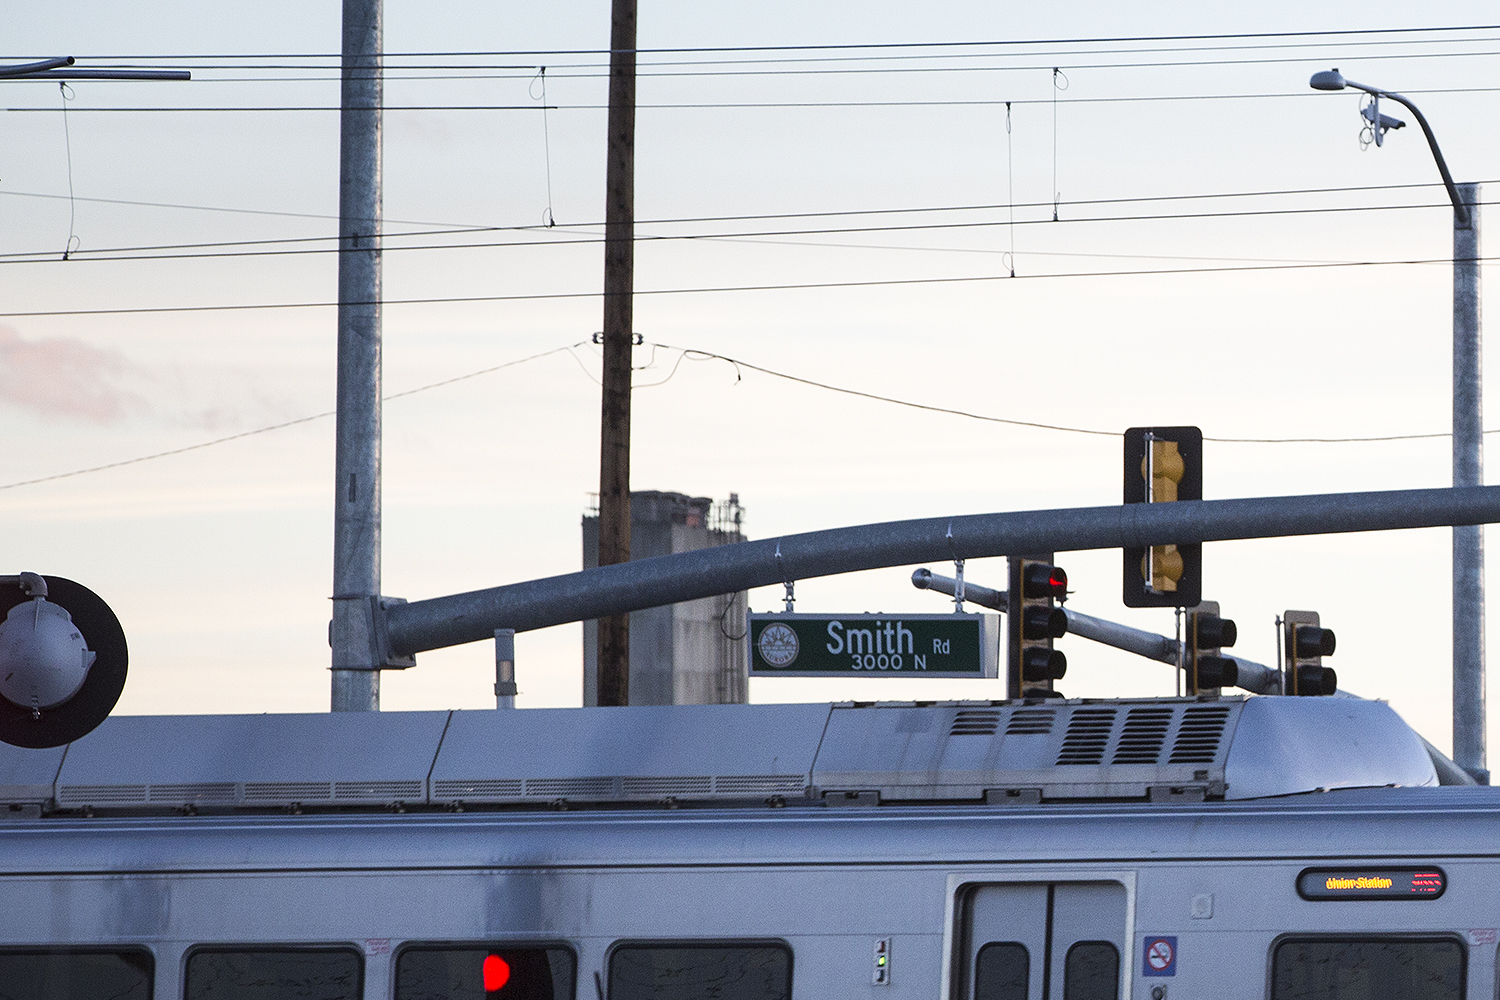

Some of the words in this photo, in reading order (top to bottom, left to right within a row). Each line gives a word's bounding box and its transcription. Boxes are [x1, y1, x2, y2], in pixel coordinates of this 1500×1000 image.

[826, 620, 914, 655] Smith
[932, 638, 950, 654] Rd
[851, 654, 903, 670] 3000
[914, 654, 927, 670] N
[1326, 877, 1355, 889] Union
[1355, 876, 1393, 889] Station
